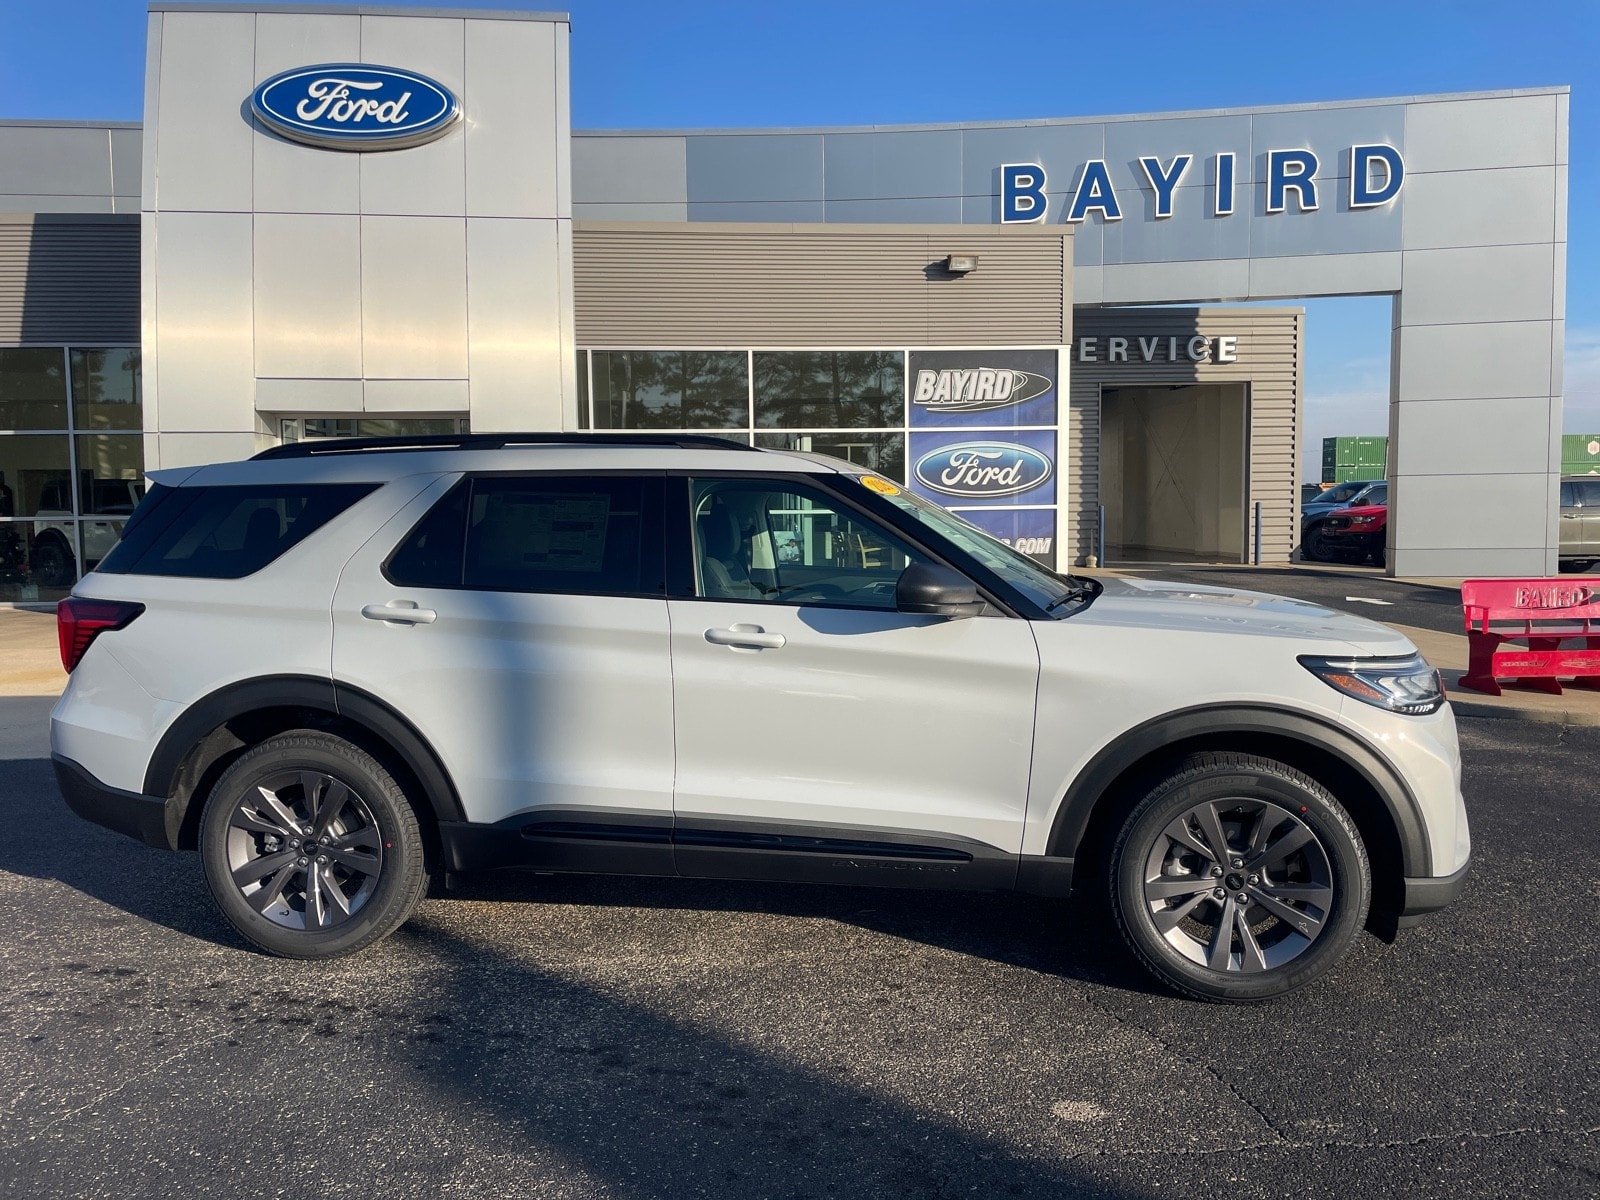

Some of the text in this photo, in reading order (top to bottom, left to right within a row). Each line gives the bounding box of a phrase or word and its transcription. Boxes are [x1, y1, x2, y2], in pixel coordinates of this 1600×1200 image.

[297, 78, 411, 124] Ford
[1001, 144, 1406, 224] BAYIRD
[1079, 335, 1238, 363] ERVICE
[914, 369, 1016, 403] BAYIRD
[941, 450, 1024, 486] Ford
[1515, 586, 1583, 609] BAYIRD
